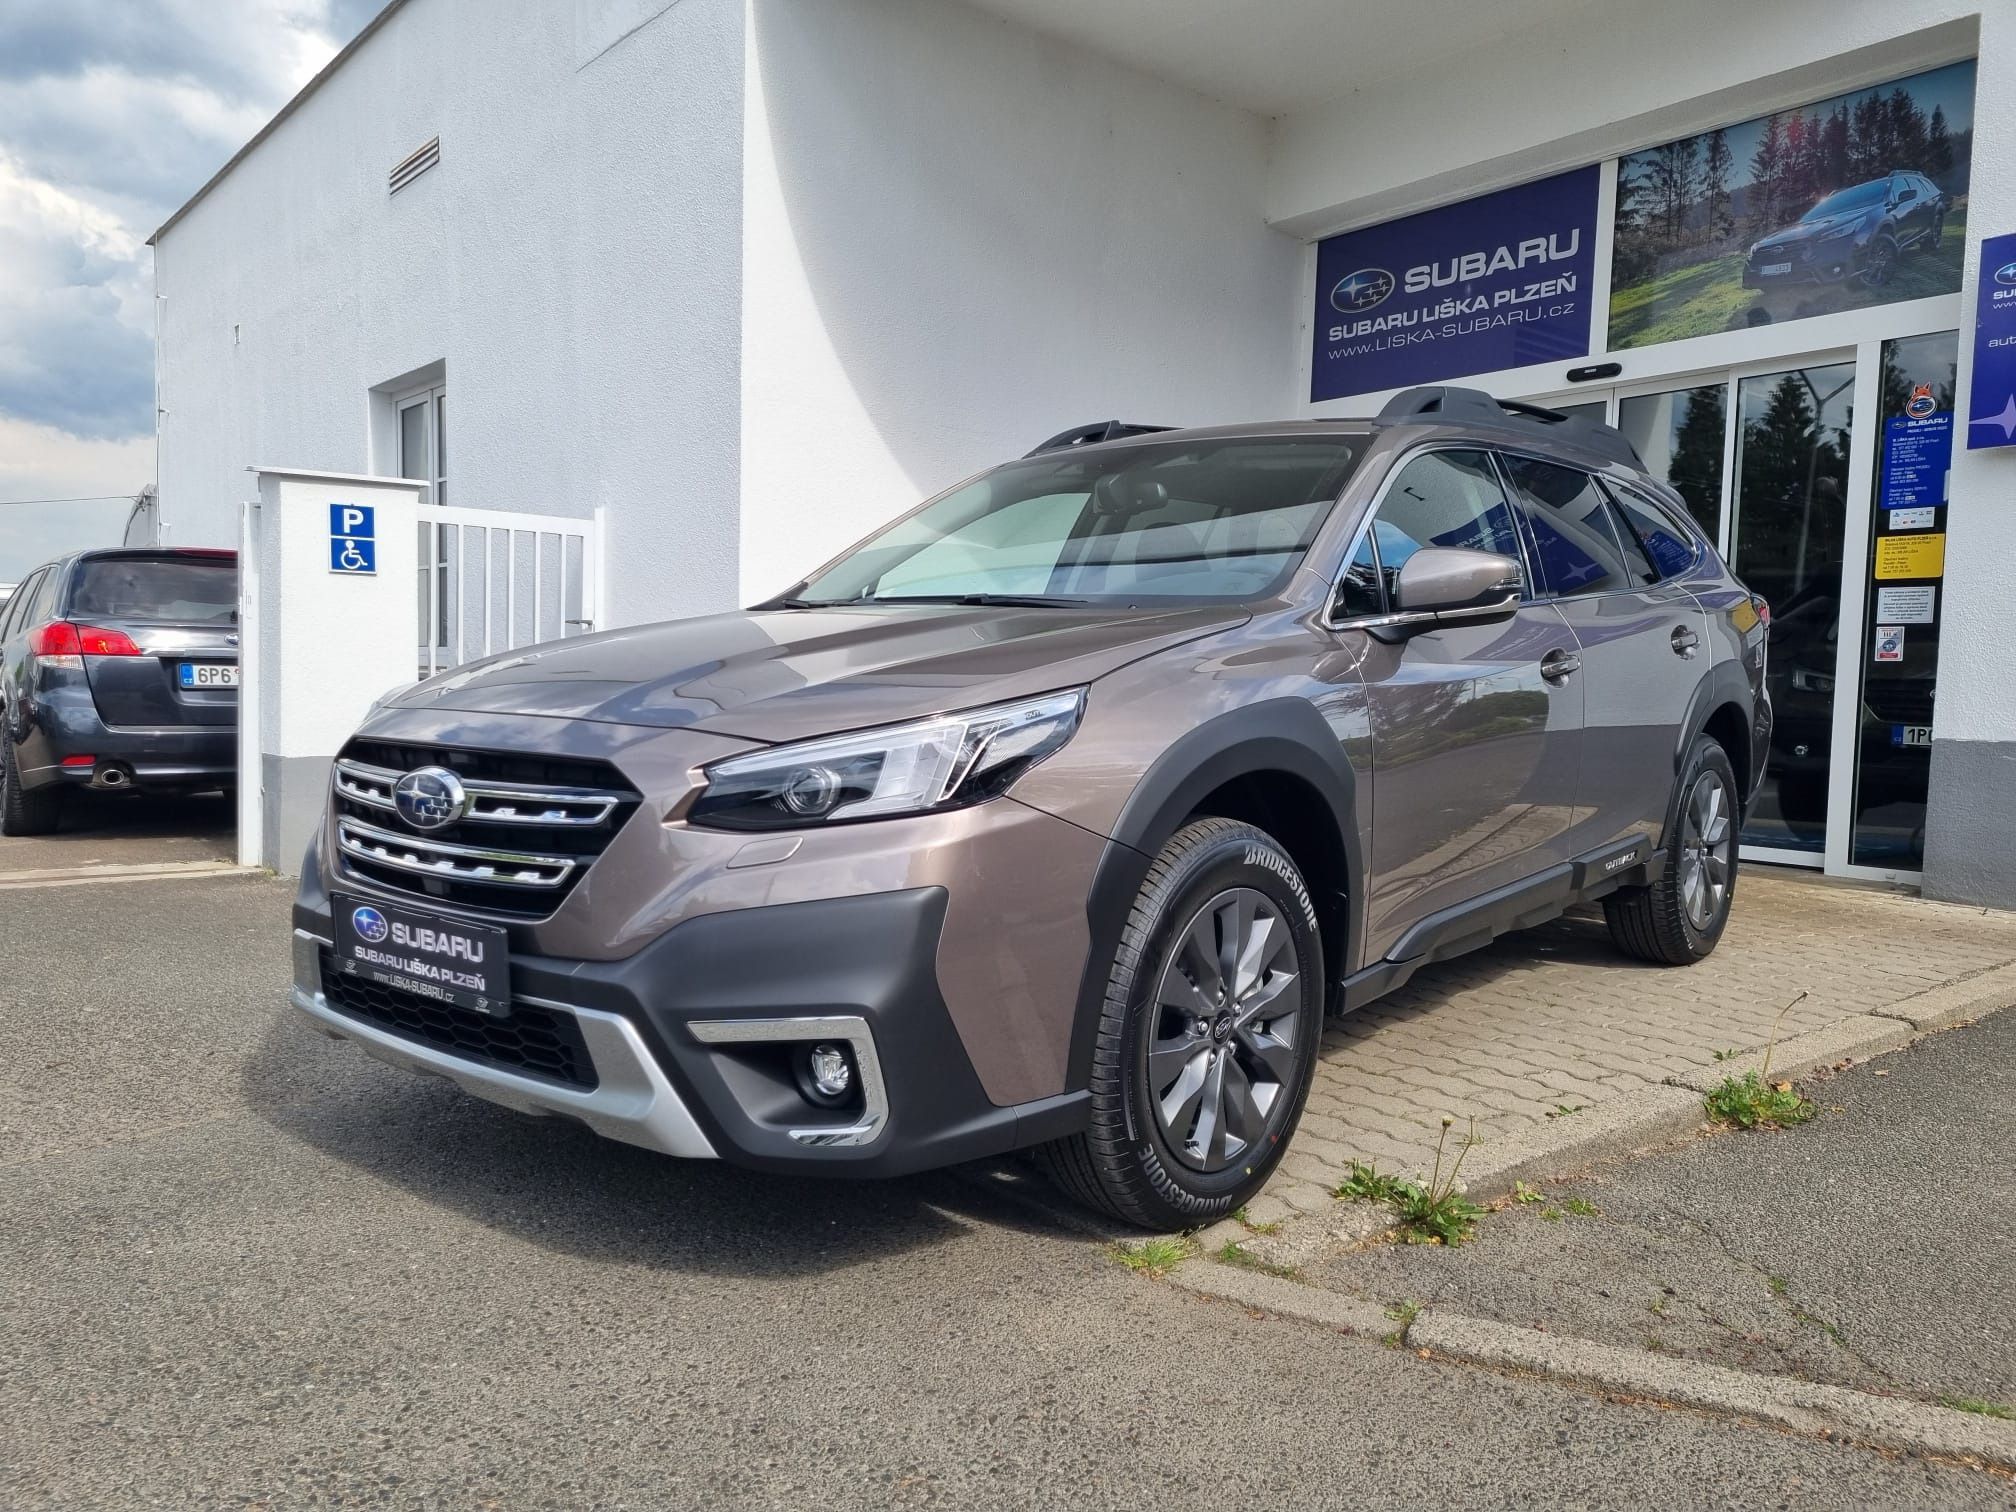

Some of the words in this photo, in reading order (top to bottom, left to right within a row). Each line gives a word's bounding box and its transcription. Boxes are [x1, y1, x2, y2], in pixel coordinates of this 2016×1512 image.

[1404, 228, 1580, 293] SUBARU
[1328, 310, 1418, 342] SUBARU
[1422, 298, 1489, 323] LIŠKA
[1493, 271, 1577, 308] PLZEŇ
[1993, 288, 2016, 300] SU
[1328, 303, 1575, 360] www.LISKA-SUBARU.cz
[1907, 417, 1948, 427] SUBARU
[343, 508, 364, 534] P
[1243, 844, 1318, 932] BRIDGESTONE
[354, 945, 403, 969] SUBARU
[404, 957, 440, 981] LIŠKA
[441, 968, 486, 992] PLZEŇ
[391, 922, 484, 963] SUBARU
[1138, 1143, 1232, 1212] BRIDGESTONE
